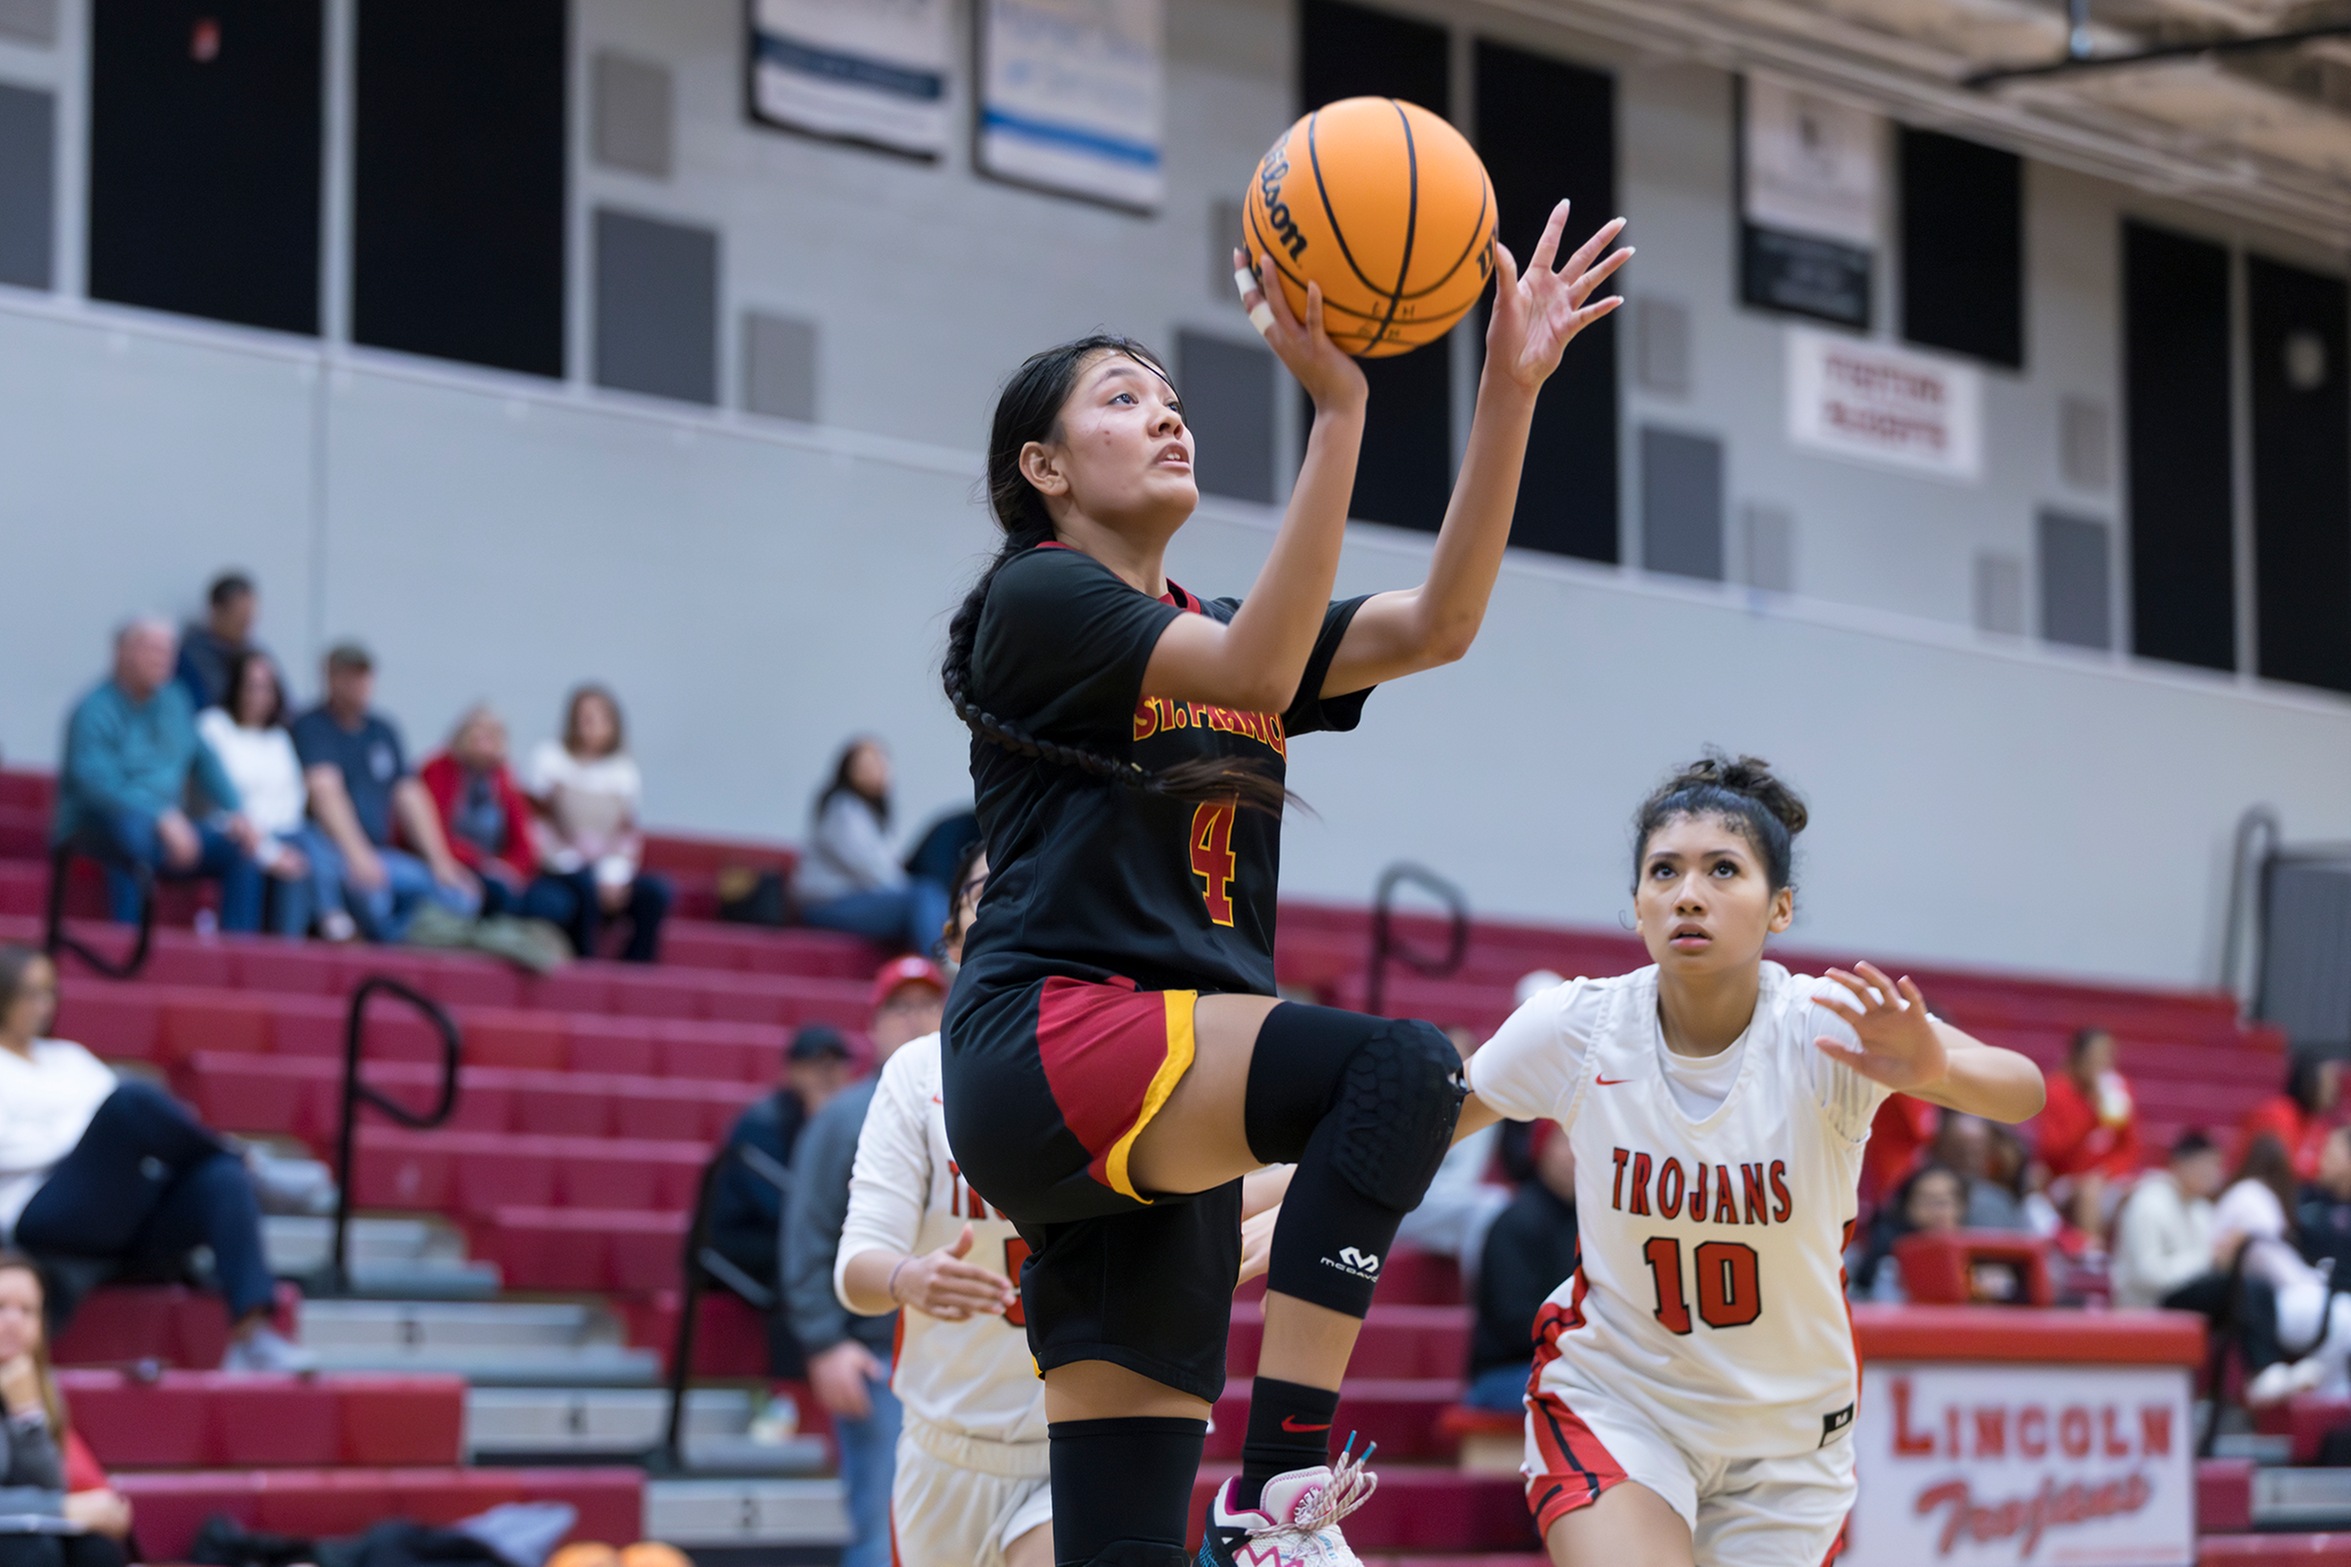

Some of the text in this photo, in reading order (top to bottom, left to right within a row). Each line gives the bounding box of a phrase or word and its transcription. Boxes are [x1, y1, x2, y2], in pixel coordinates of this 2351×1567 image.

[1190, 793, 1237, 928] 4
[1612, 1146, 1793, 1226] TROJANS
[1643, 1236, 1762, 1336] 10
[1889, 1377, 2173, 1460] LINCOLN
[1914, 1472, 2153, 1558] Trojans
